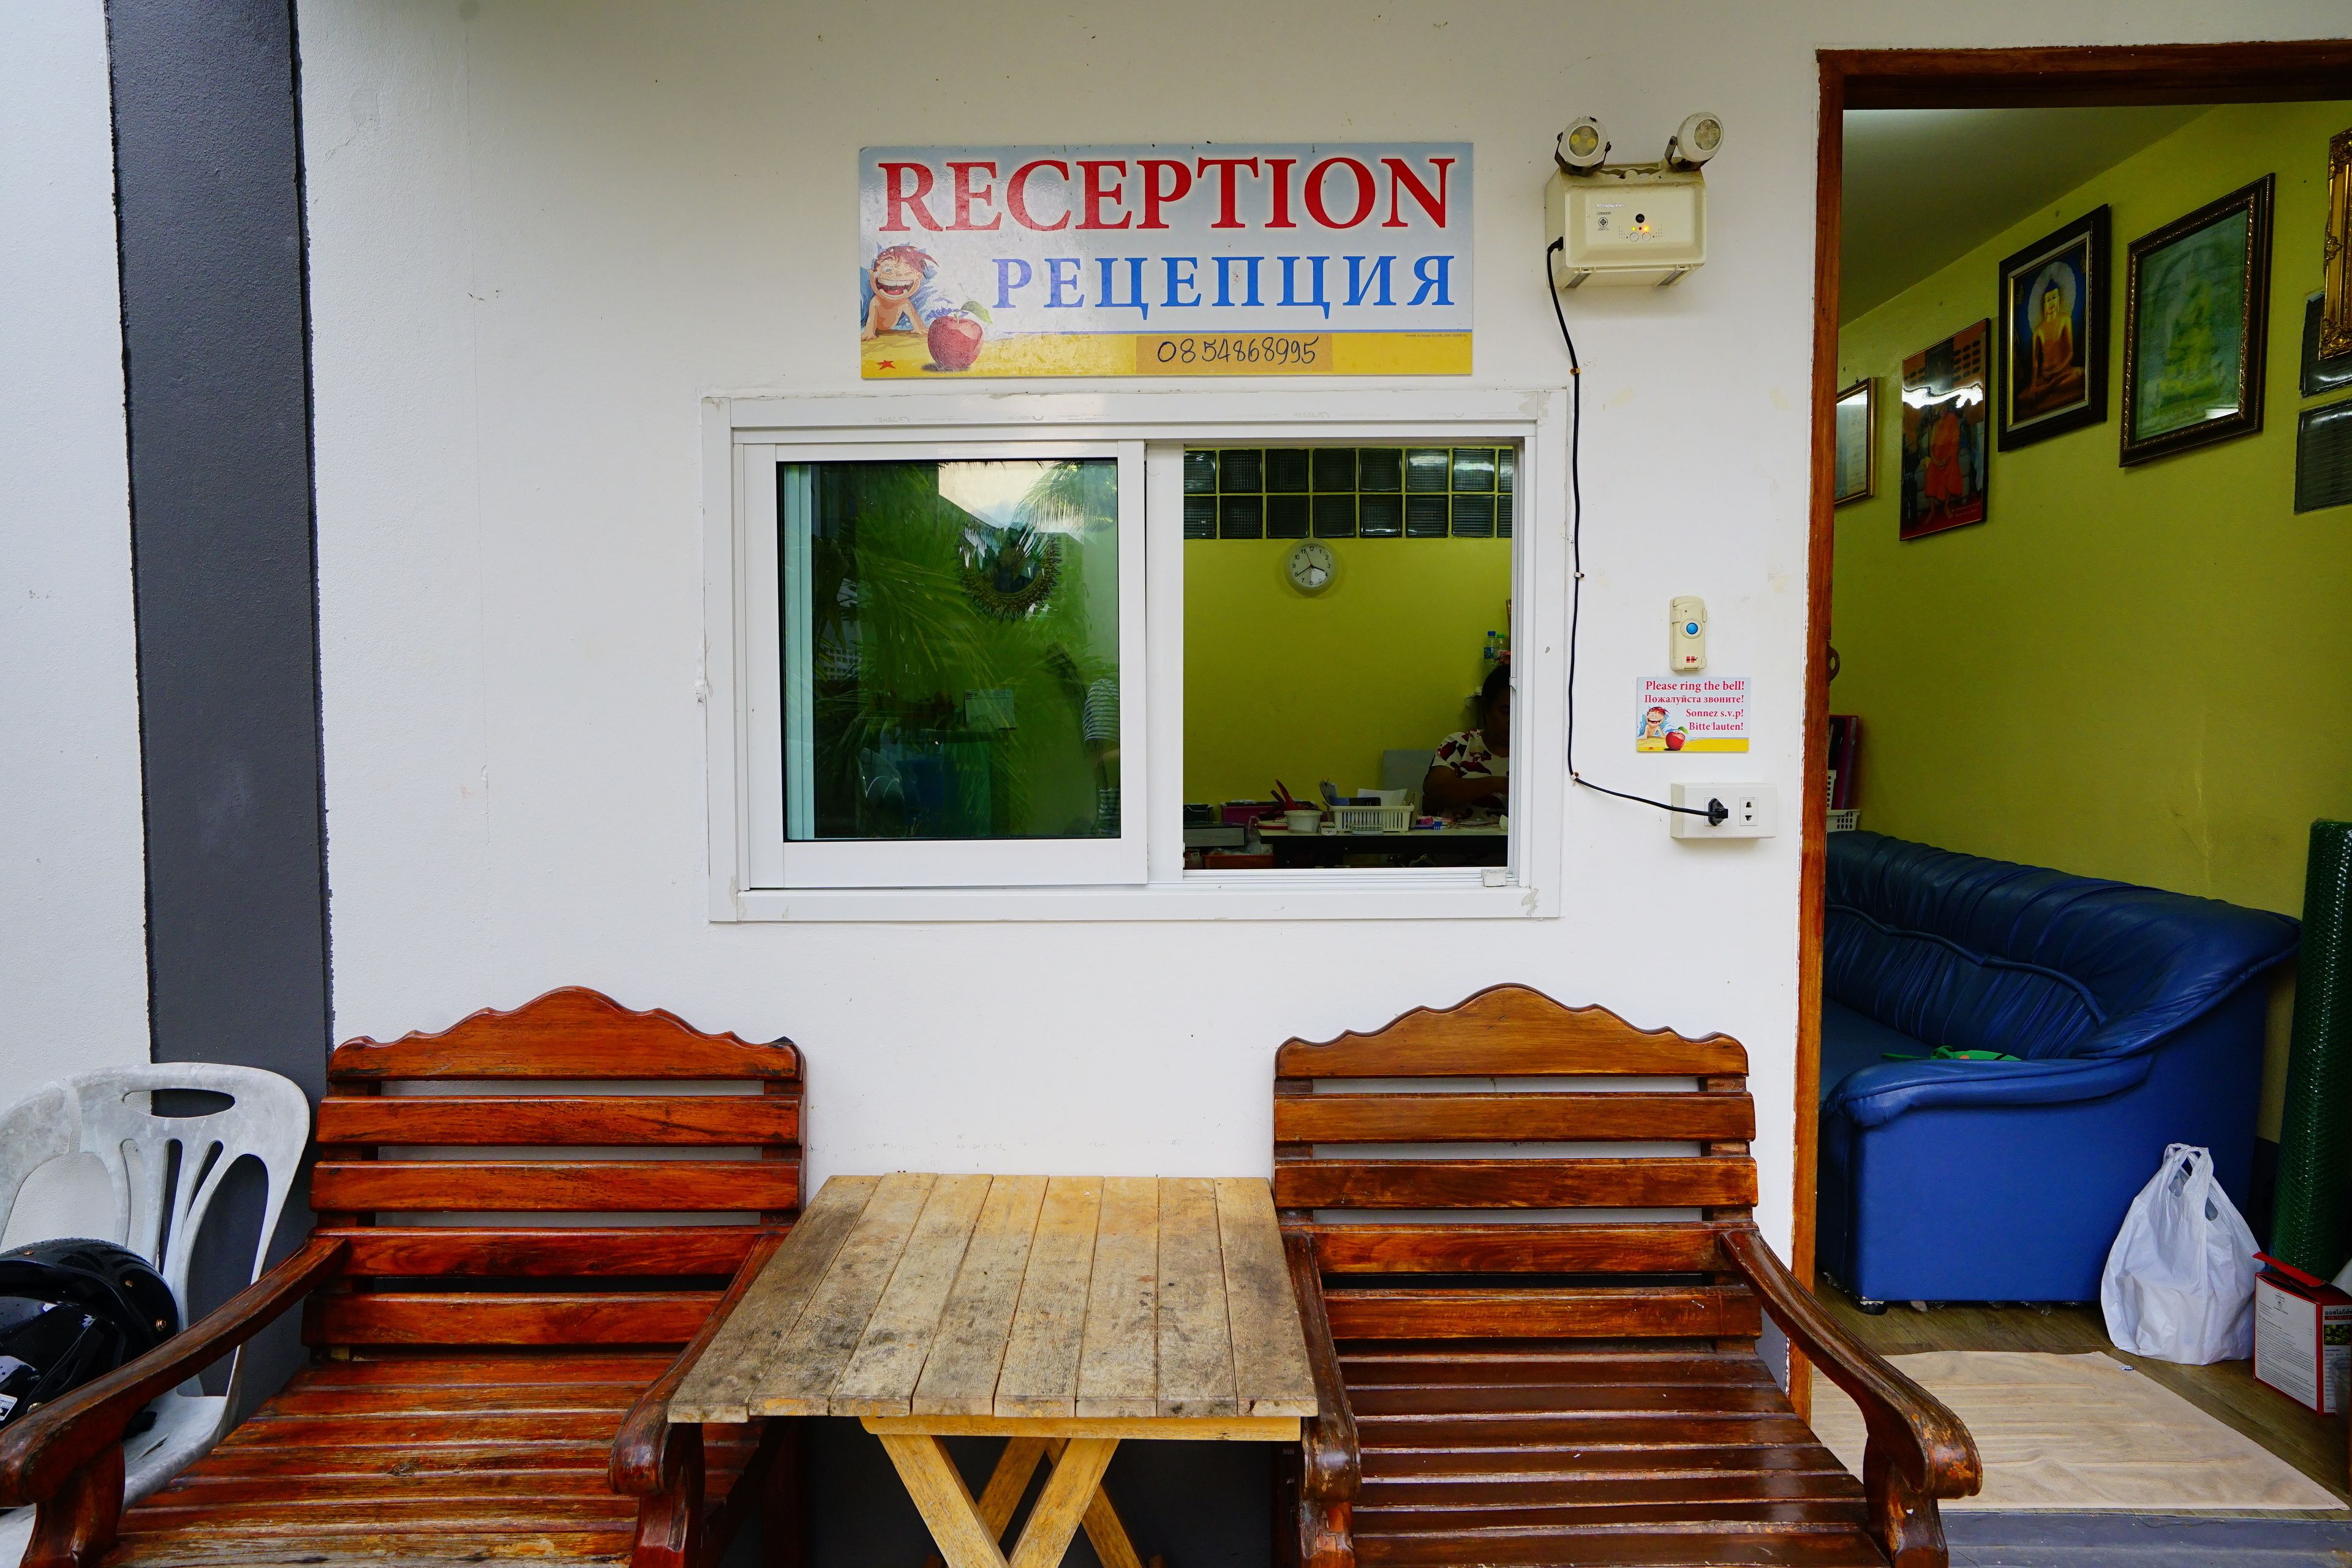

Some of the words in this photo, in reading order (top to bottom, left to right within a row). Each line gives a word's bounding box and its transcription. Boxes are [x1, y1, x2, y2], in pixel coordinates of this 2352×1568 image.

[878, 157, 1455, 232] RECEPTION
[992, 255, 1455, 320] РЕЦЕПЦИЯ
[1158, 336, 1319, 365] 0854868995
[1646, 680, 1677, 690] Please
[1680, 681, 1702, 693] ring
[1704, 680, 1720, 690] the
[1723, 680, 1744, 690] bell!
[1645, 695, 1701, 705] Пожалуйста
[1703, 695, 1744, 703] звоните!
[1686, 709, 1718, 717] Sonnez
[1721, 709, 1744, 719] s.v.p!
